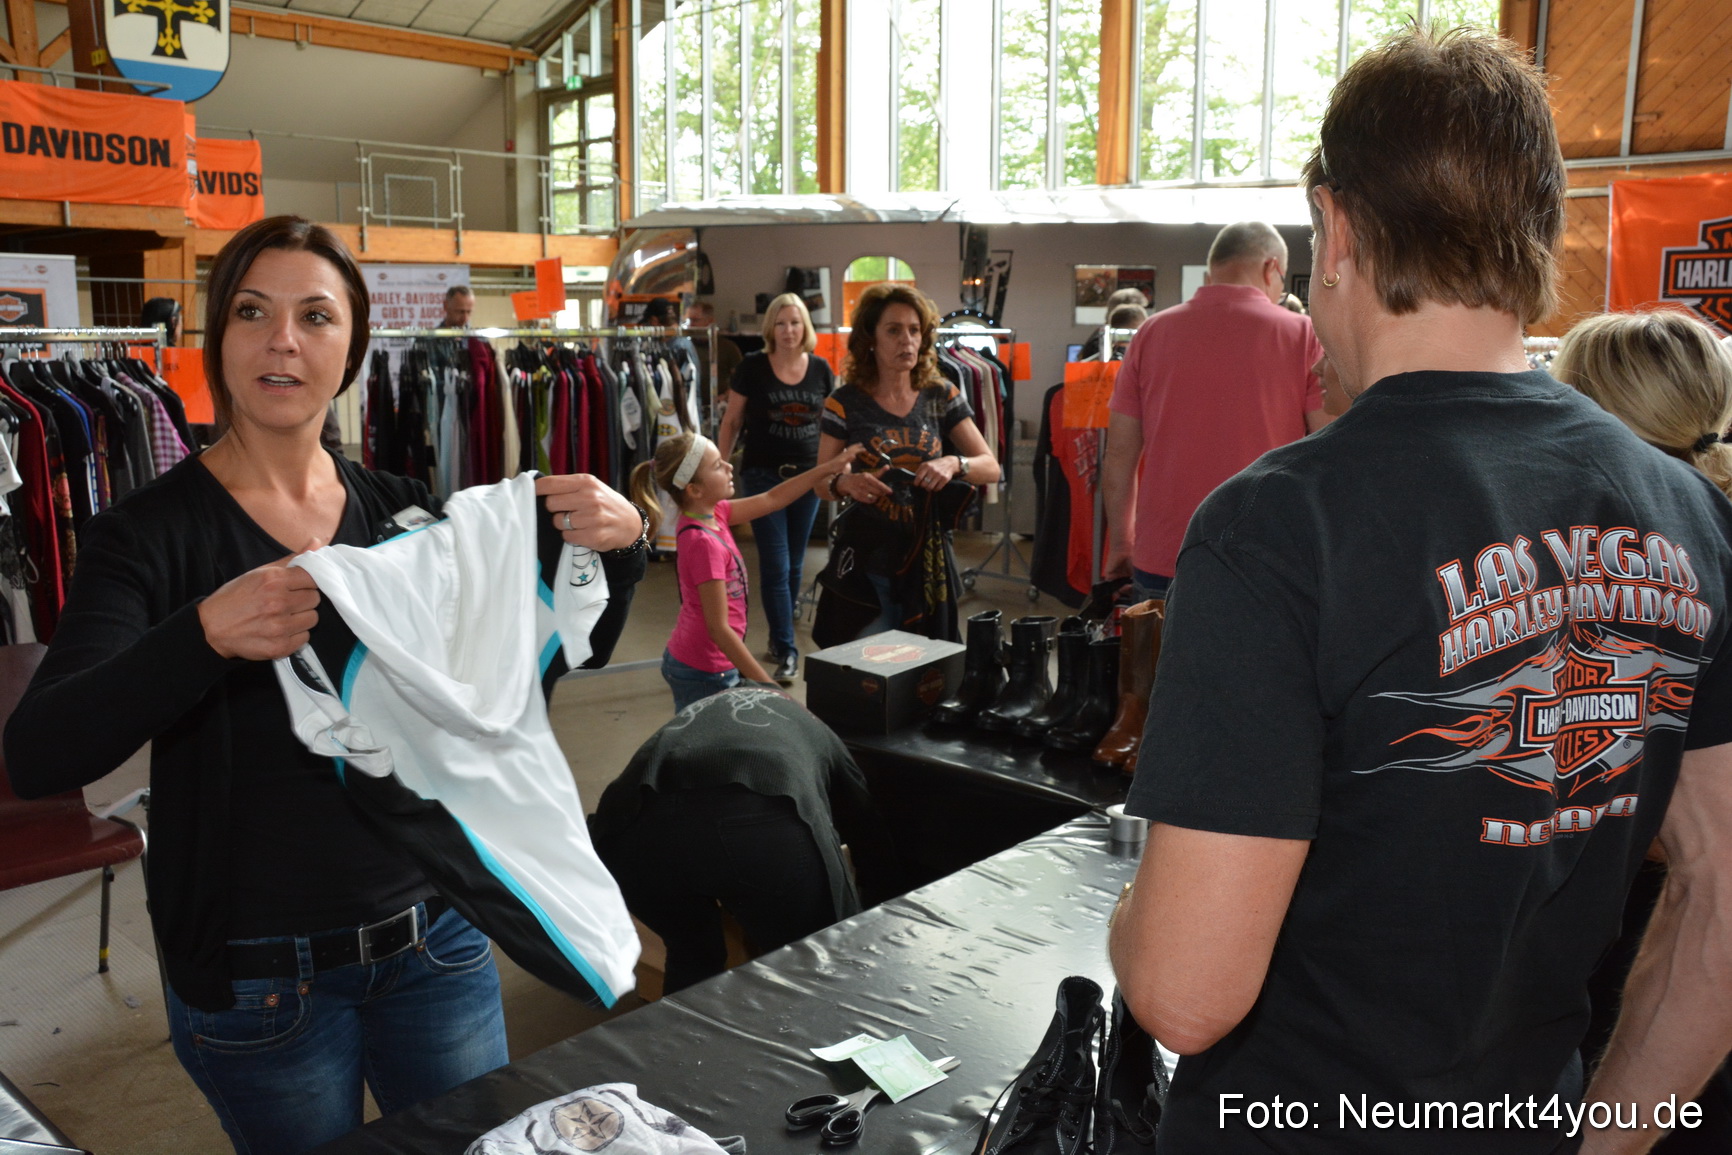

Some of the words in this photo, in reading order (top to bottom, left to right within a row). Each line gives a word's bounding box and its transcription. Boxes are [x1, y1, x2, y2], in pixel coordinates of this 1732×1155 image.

[1, 121, 171, 168] DAVIDSON
[197, 170, 262, 196] VIDS
[1677, 259, 1732, 289] HARL
[370, 291, 446, 305] ARLEY-DAVIDS
[768, 422, 820, 440] DAVIDSO
[1437, 535, 1538, 625] LAS
[1541, 526, 1699, 594] VEGAS
[1557, 729, 1599, 767] CLES
